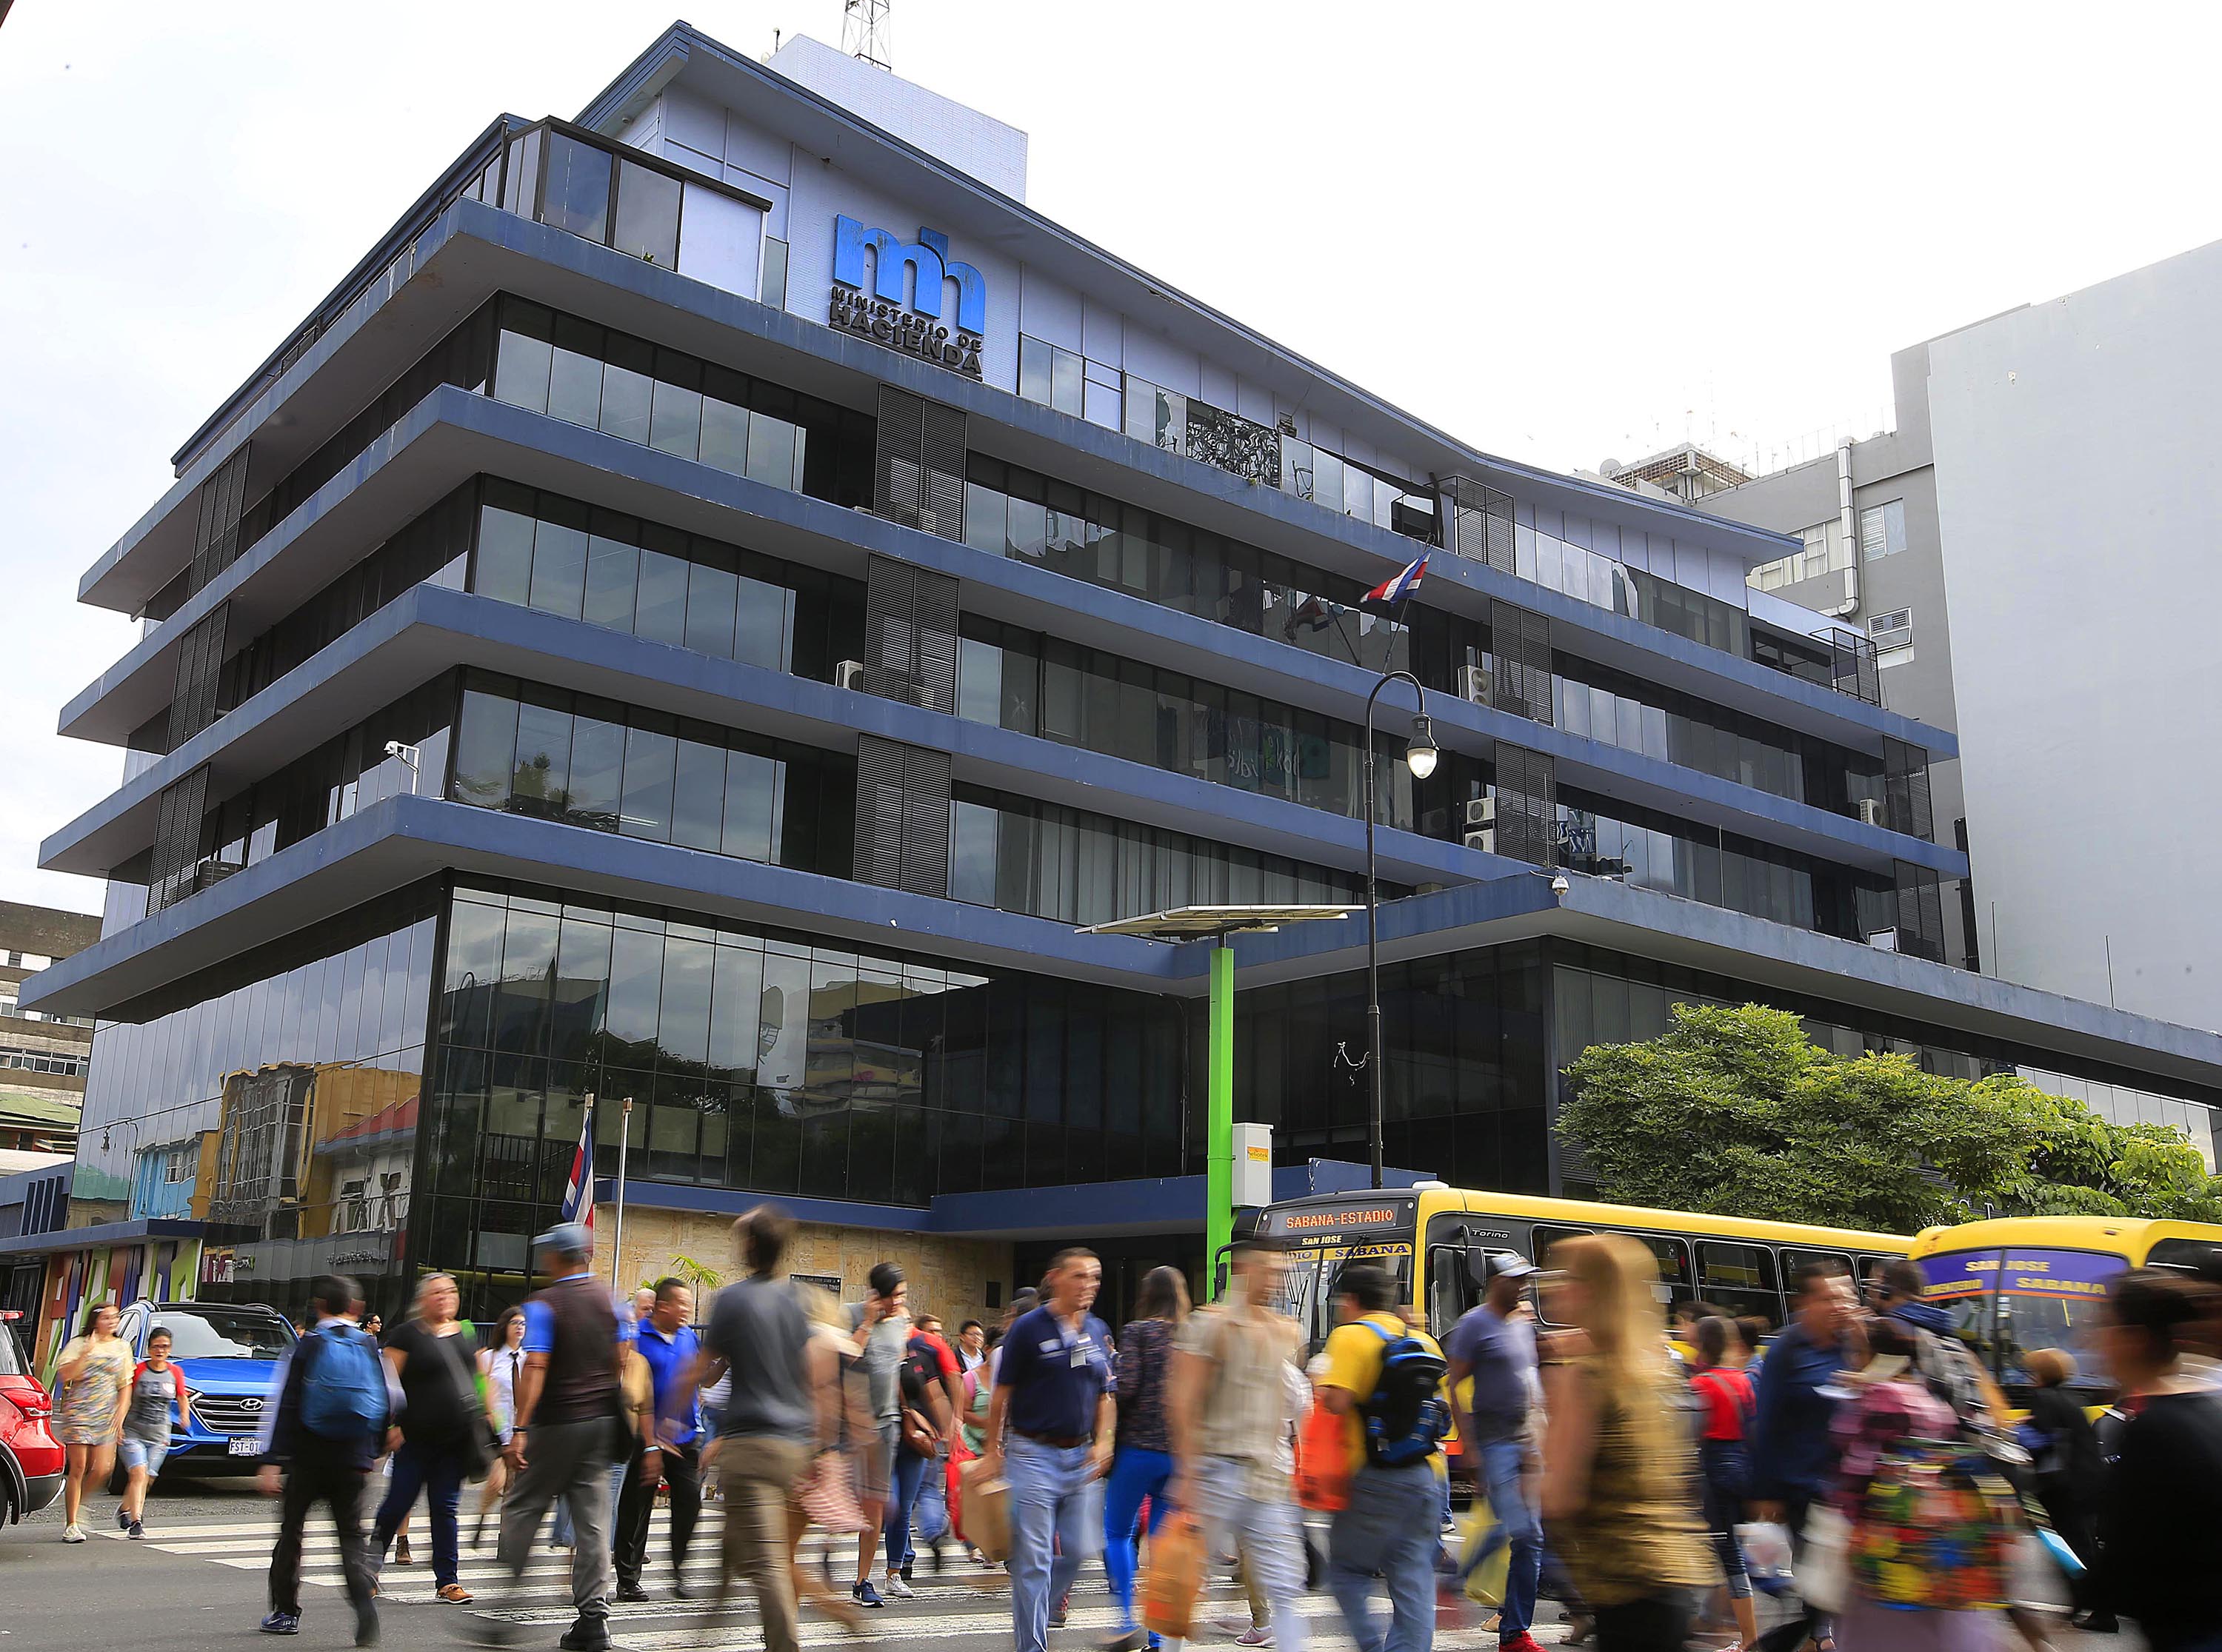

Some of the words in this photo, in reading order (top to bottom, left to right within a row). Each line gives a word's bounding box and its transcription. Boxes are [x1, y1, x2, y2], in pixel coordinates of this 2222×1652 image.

[831, 286, 950, 339] MINISTERIO
[958, 333, 982, 352] DE
[830, 301, 982, 374] HACIENDA
[1287, 1209, 1393, 1228] SABANA-ESTADIO
[1301, 1237, 1319, 1246] SAN
[1320, 1234, 1343, 1245] JOSE
[1472, 1229, 1509, 1239] Torino
[1335, 1244, 1409, 1258] SABANA
[2016, 1277, 2106, 1294] SABANA
